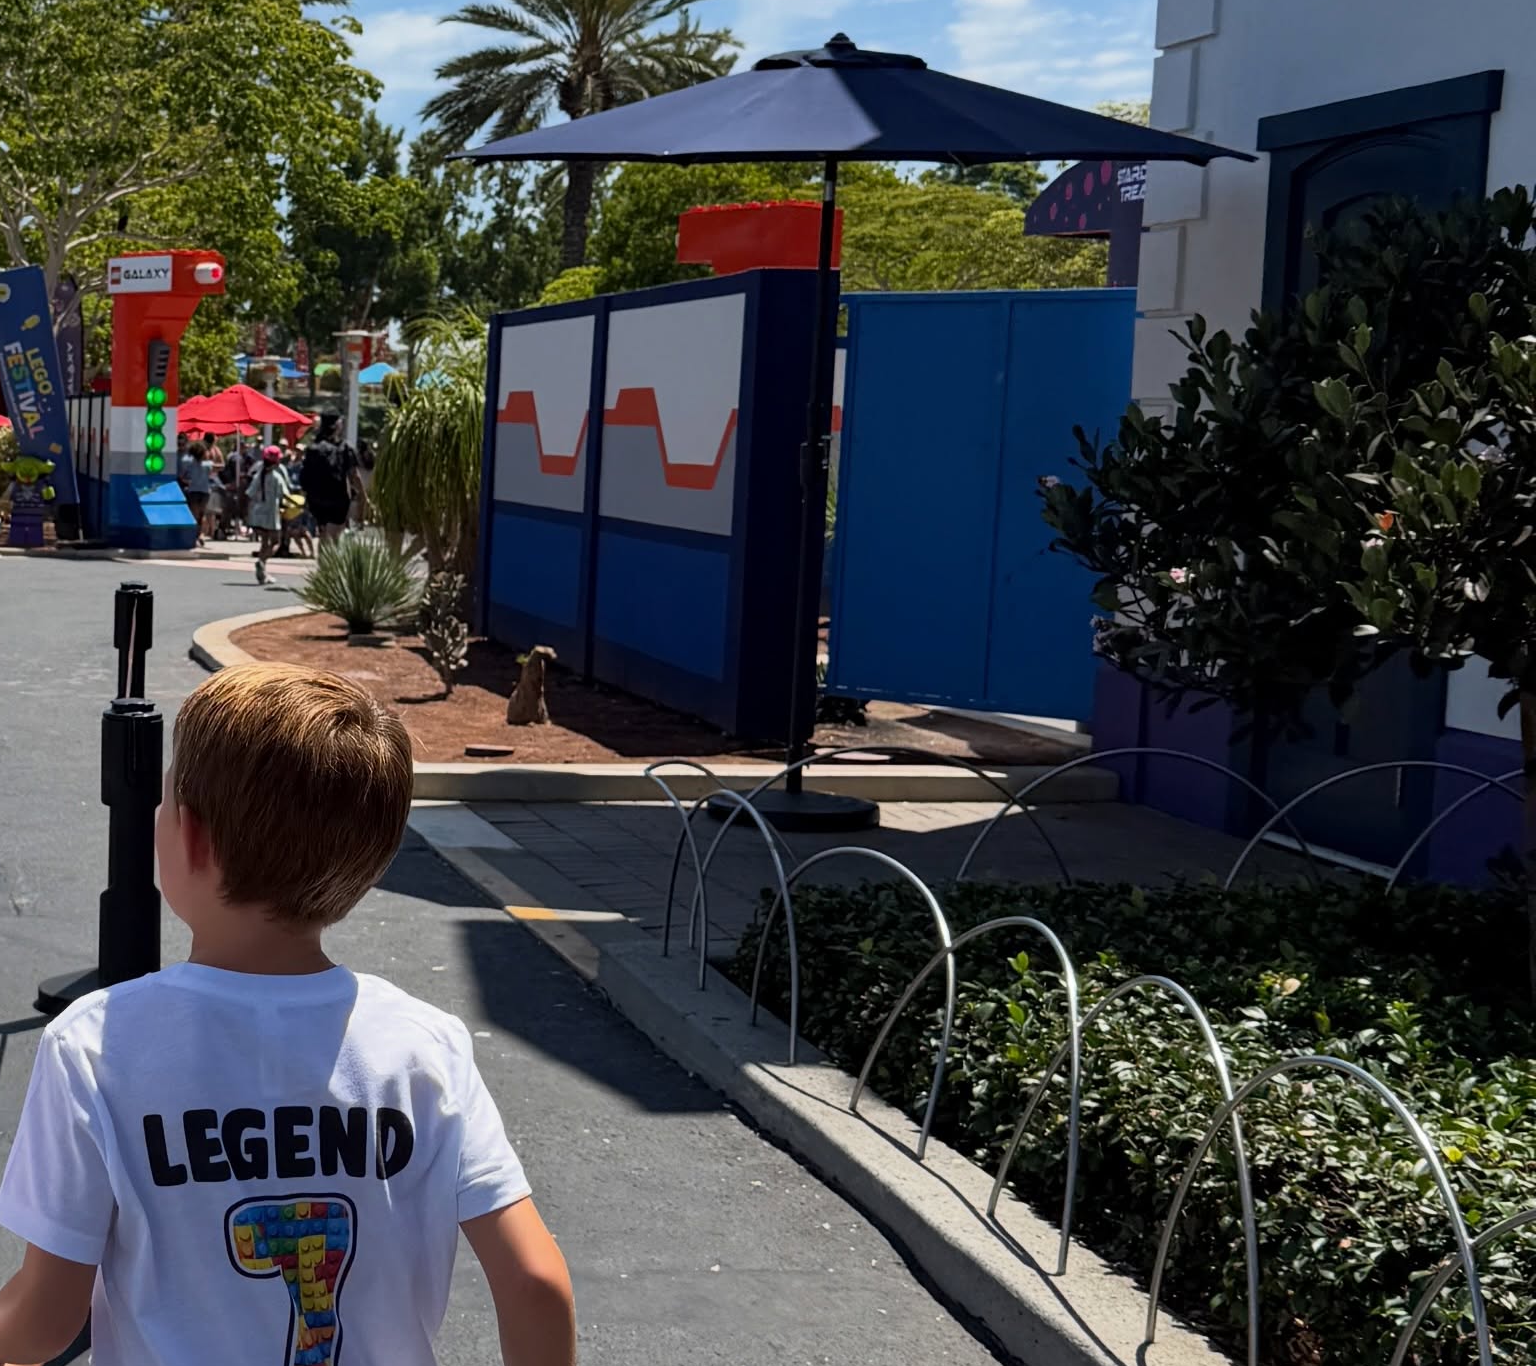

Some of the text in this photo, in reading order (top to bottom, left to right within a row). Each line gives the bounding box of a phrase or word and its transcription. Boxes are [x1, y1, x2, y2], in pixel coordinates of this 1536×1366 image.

[123, 267, 170, 280] GALAXY
[4, 341, 45, 439] FESTIVAL
[25, 347, 54, 395] LEGO
[66, 342, 75, 395] ALAXY
[143, 1106, 414, 1186] LEGEND
